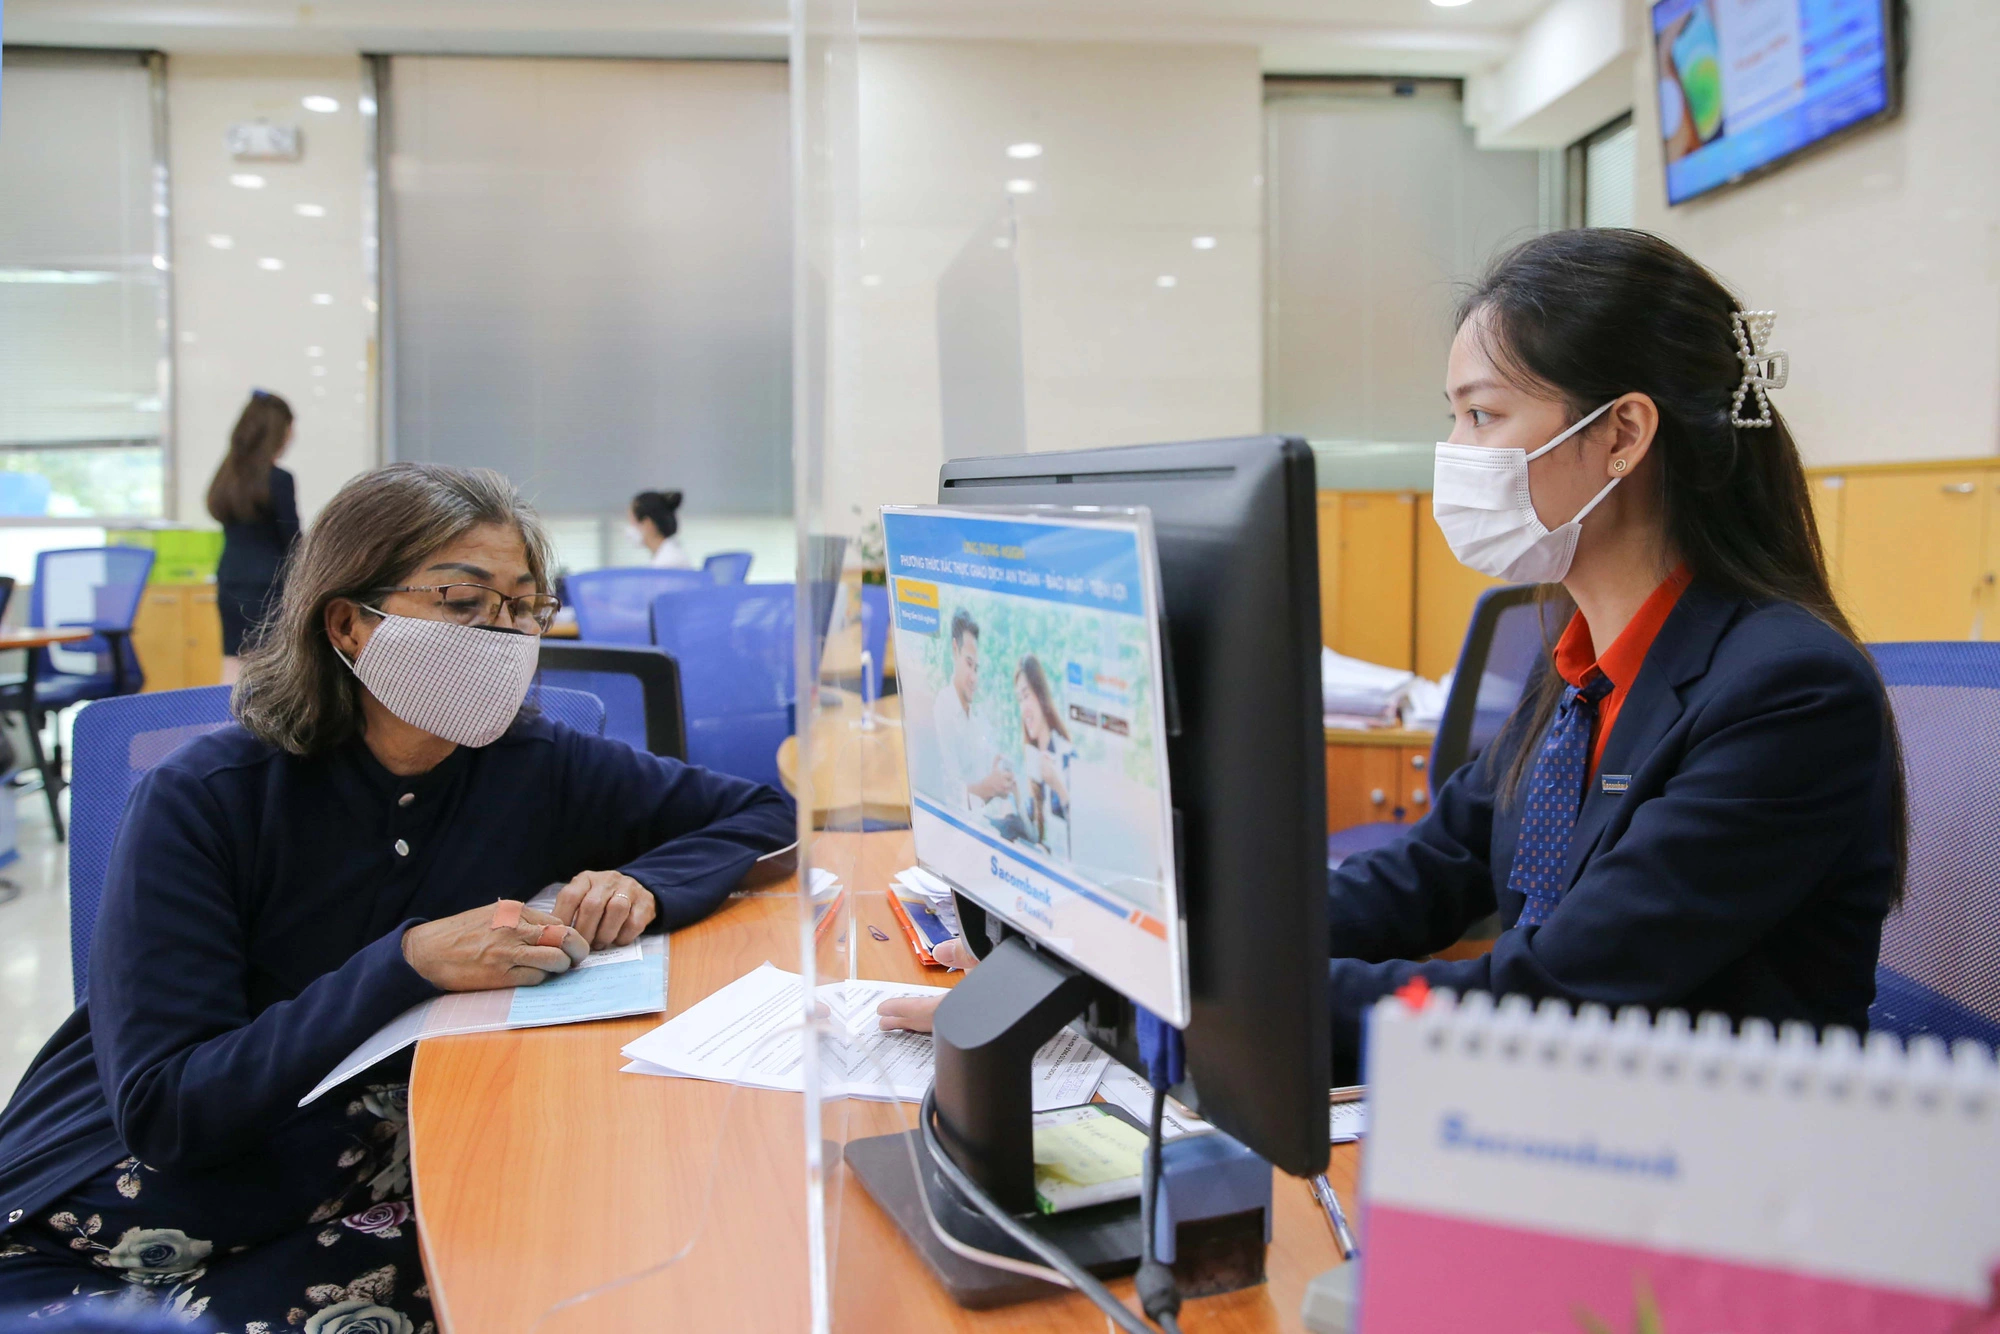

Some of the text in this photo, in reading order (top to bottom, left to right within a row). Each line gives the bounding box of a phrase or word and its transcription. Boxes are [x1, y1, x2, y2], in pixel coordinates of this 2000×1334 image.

[970, 564, 987, 579] GIAO
[1005, 568, 1018, 584] AN
[990, 855, 1052, 906] Sacombank
[1440, 1109, 1681, 1180] Sacombank
